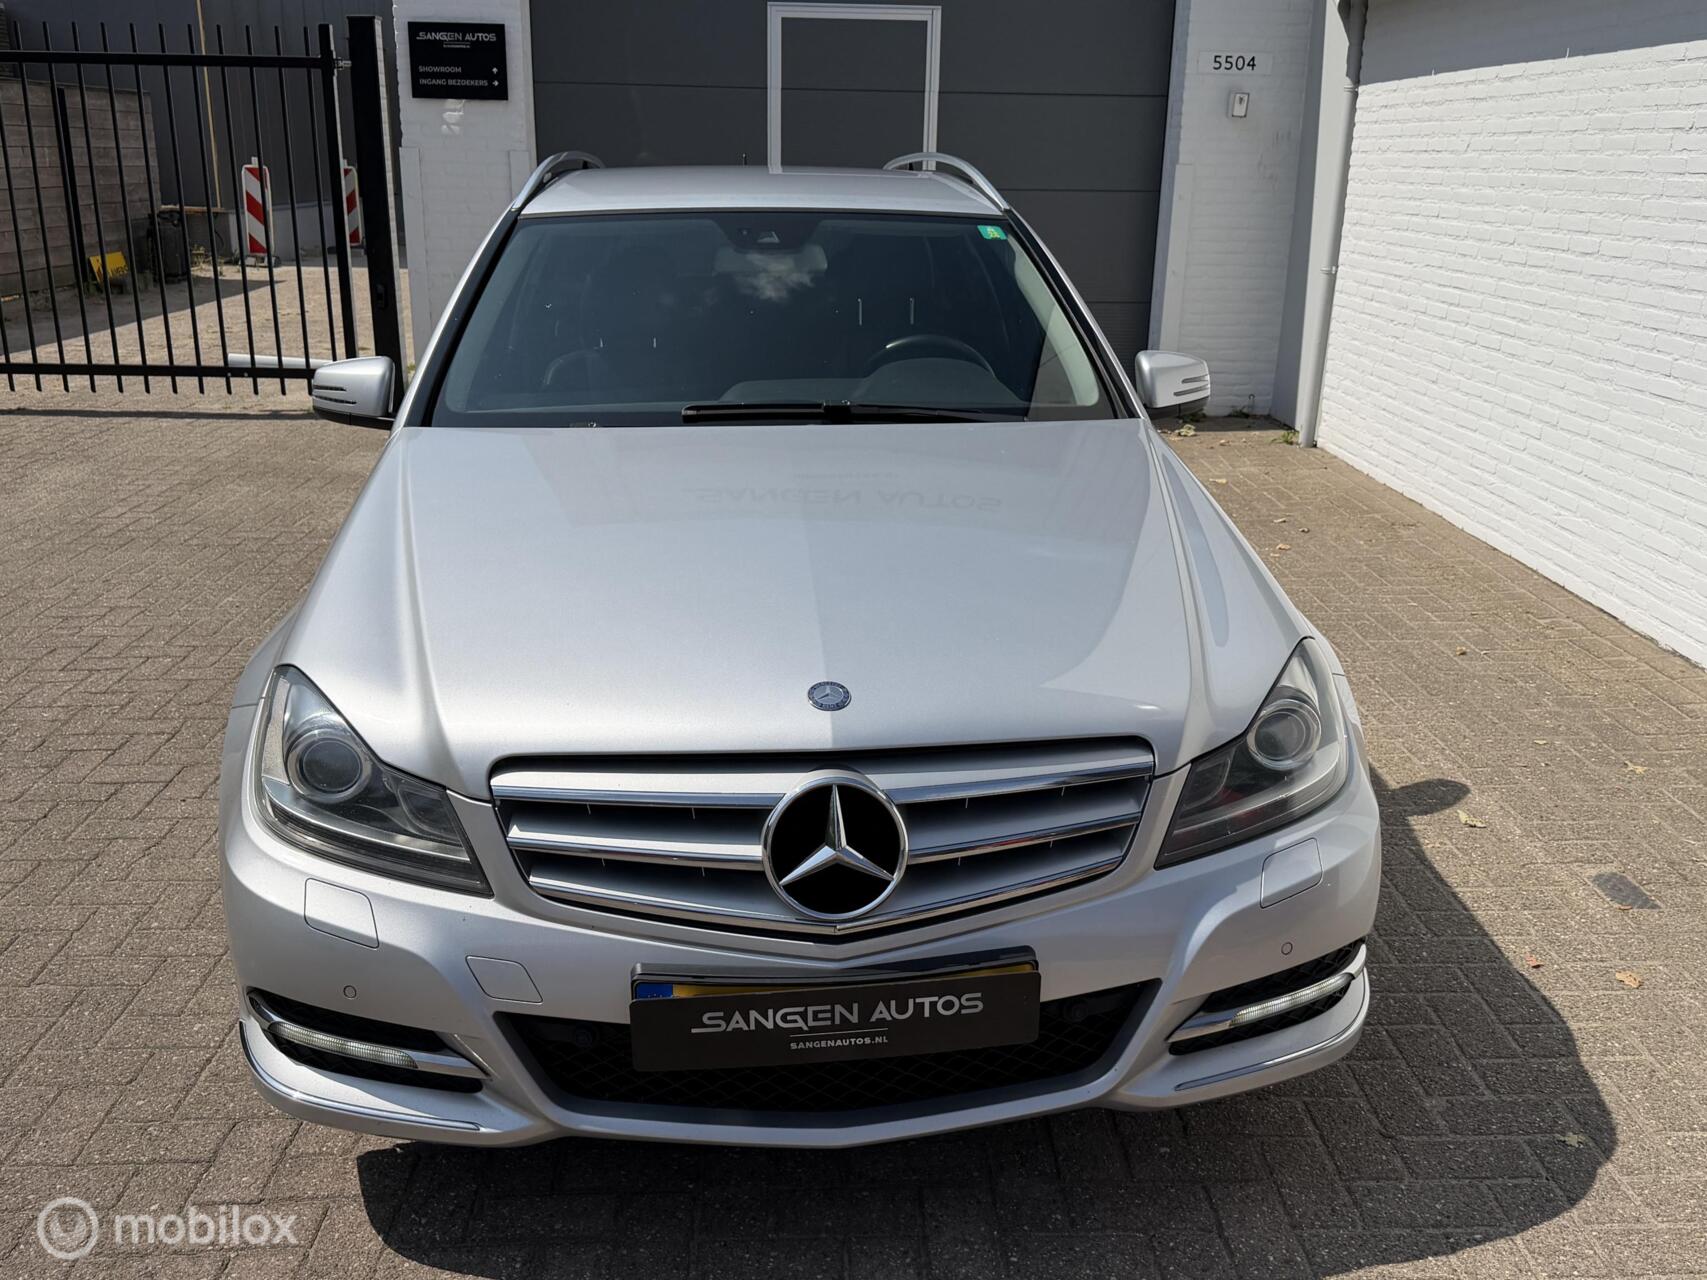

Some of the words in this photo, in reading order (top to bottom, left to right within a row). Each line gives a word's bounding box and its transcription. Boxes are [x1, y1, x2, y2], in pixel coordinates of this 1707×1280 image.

[416, 31, 462, 42] SANGEN
[464, 32, 497, 42] AUTOS
[418, 65, 462, 73] SHOWROOM
[1213, 55, 1257, 71] 5504
[419, 78, 447, 86] INGANG
[447, 79, 488, 87] BEZOEKERS
[691, 1002, 859, 1033] SANGEN
[869, 992, 985, 1023] AUTOS
[790, 1035, 889, 1050] SANGENAUTOS.NL
